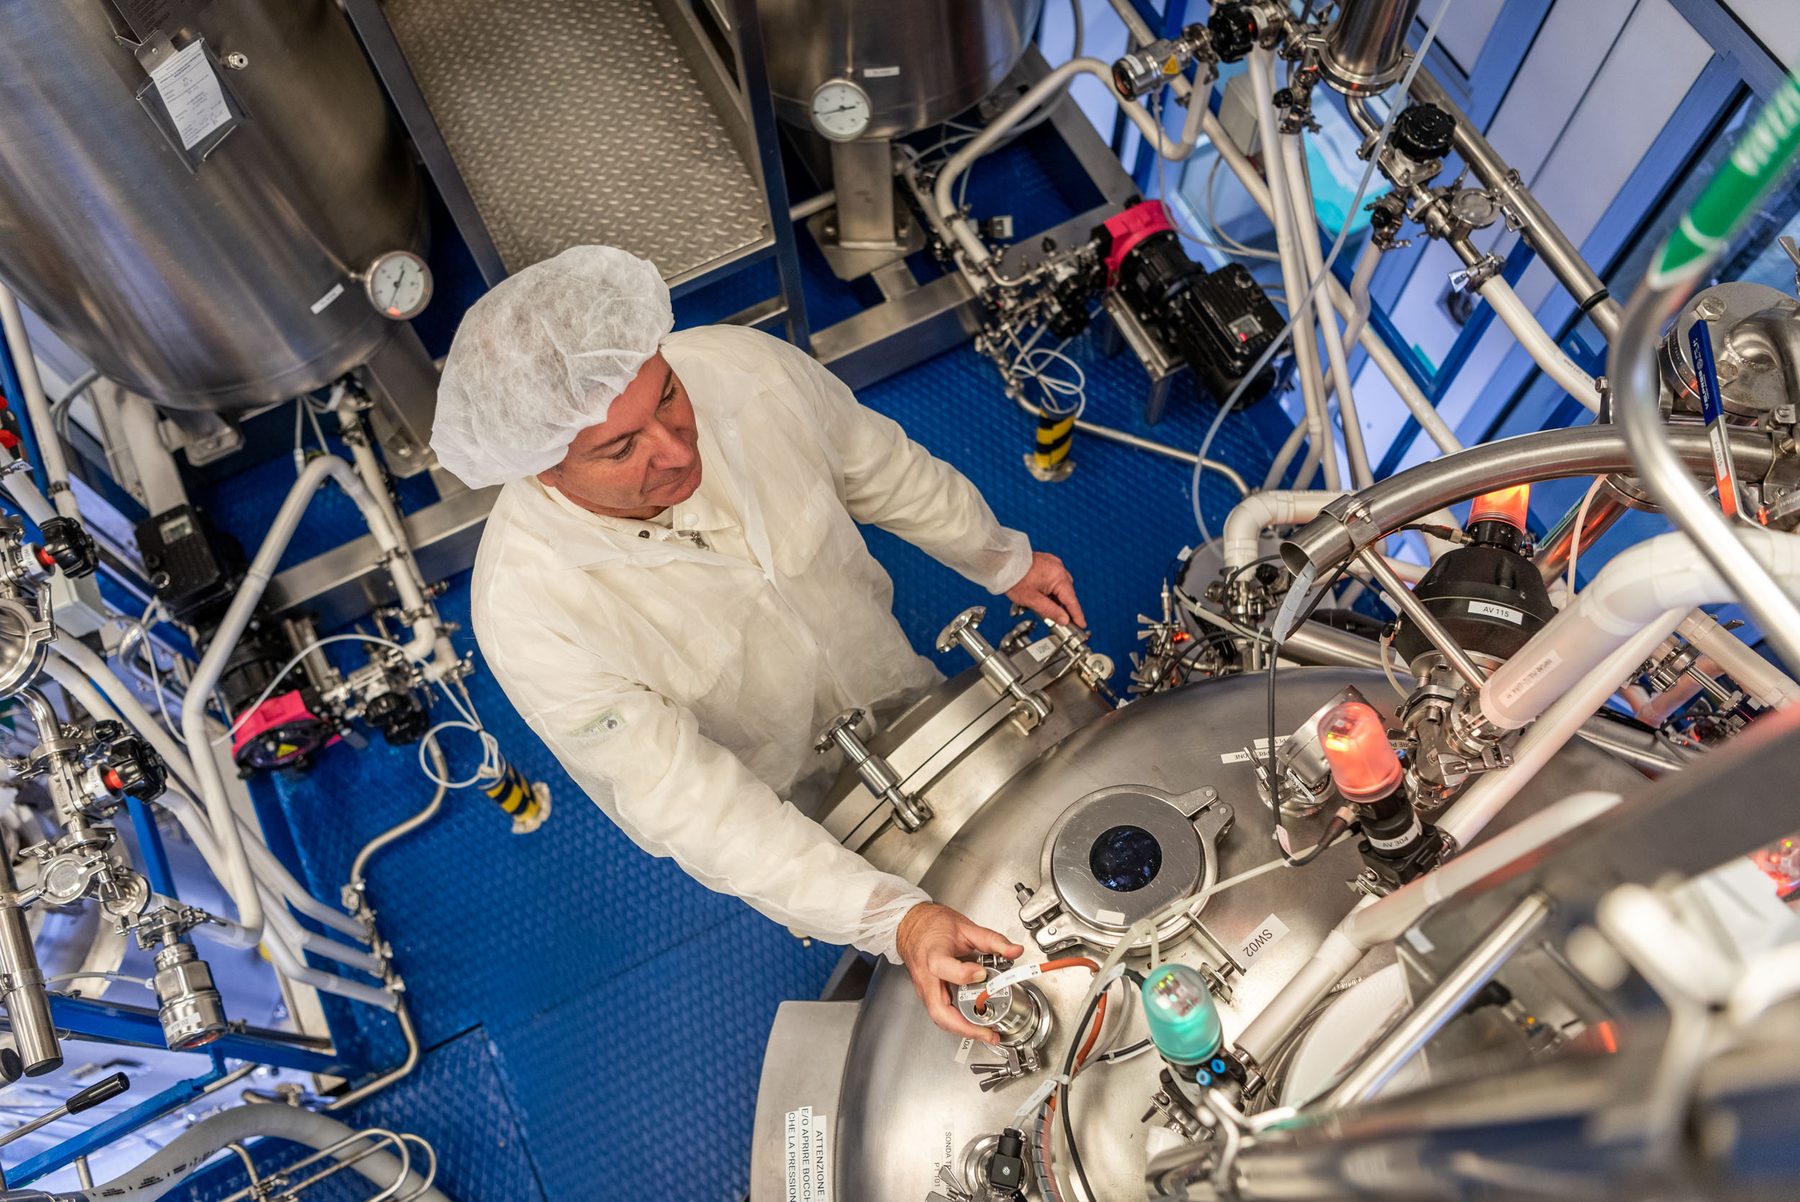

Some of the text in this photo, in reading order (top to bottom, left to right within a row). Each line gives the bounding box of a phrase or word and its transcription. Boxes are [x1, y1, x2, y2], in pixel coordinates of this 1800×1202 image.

[1482, 606, 1509, 618] AV 115
[1243, 926, 1273, 958] SW02
[788, 1137, 795, 1149] LA
[802, 1128, 810, 1166] APRIRE
[816, 1131, 825, 1196] ATTENZIONE
